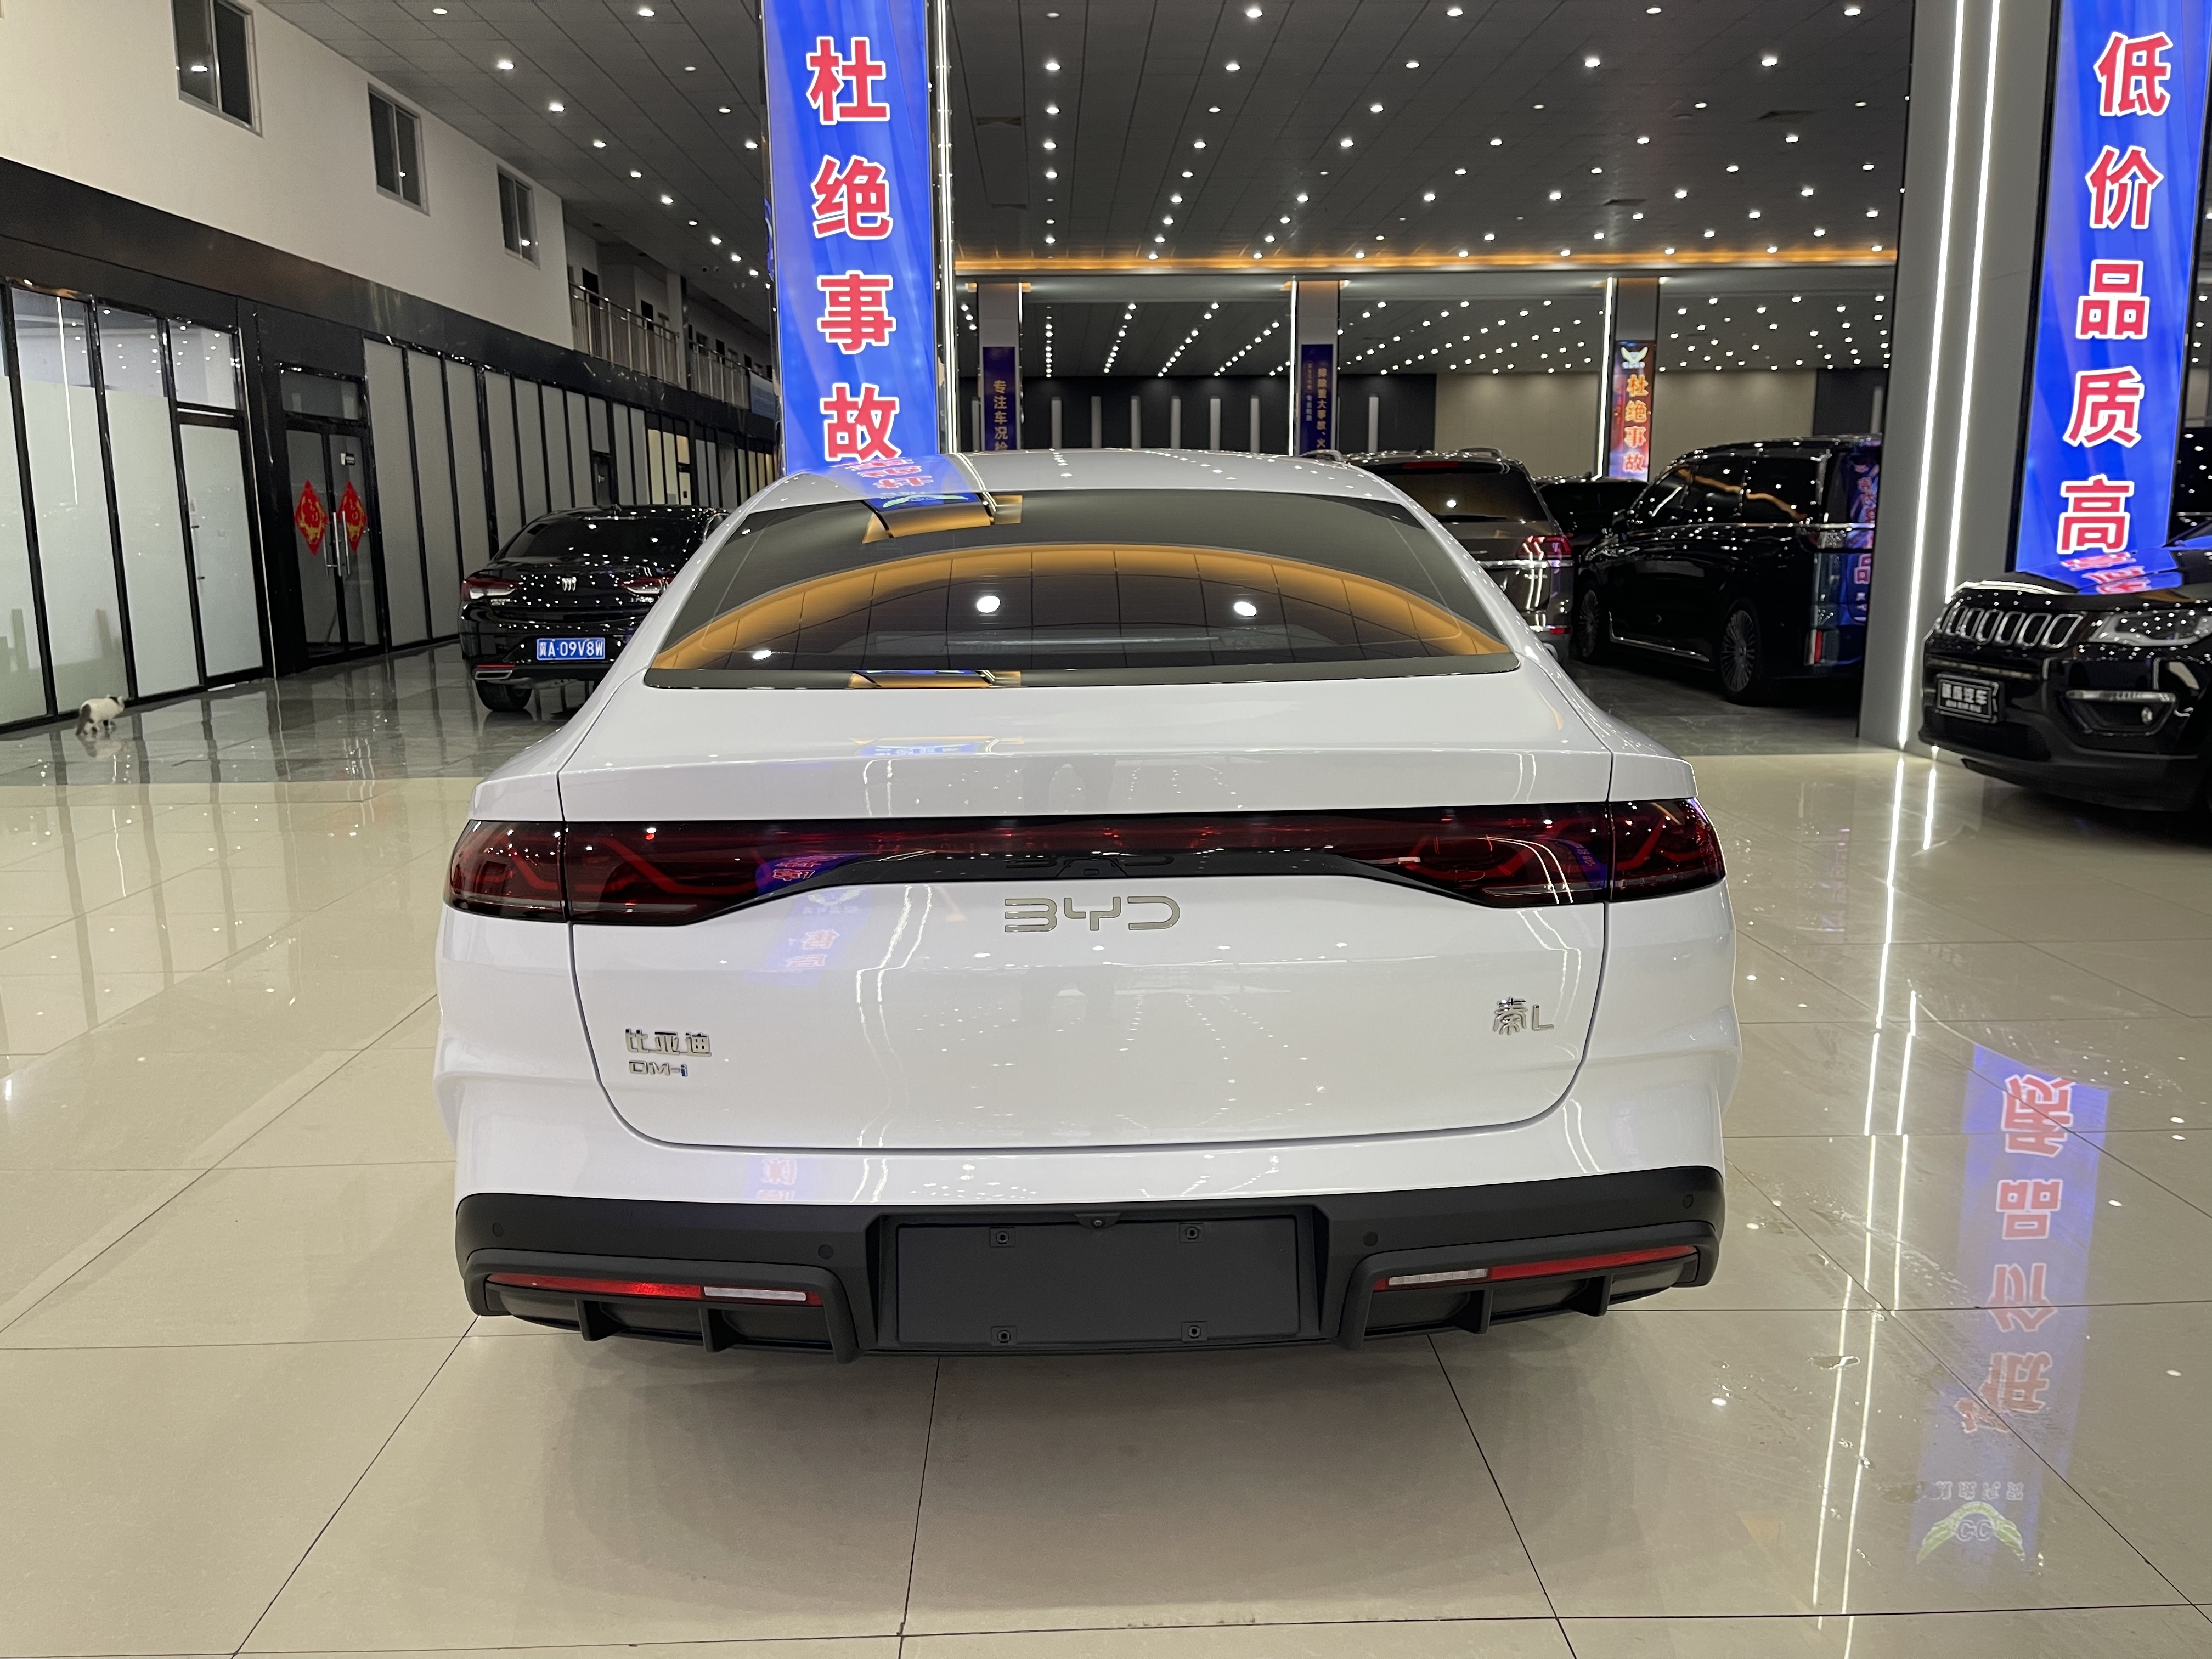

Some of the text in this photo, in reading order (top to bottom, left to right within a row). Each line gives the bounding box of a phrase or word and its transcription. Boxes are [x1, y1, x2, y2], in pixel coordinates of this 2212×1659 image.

[806, 36, 902, 462] 杜绝事故
[2056, 31, 2173, 554] 低价品质高
[1623, 374, 1649, 472] 杜绝事故
[1005, 895, 1181, 933] BYD
[625, 1028, 712, 1057] 比亚迪
[629, 1060, 688, 1077] DM-i
